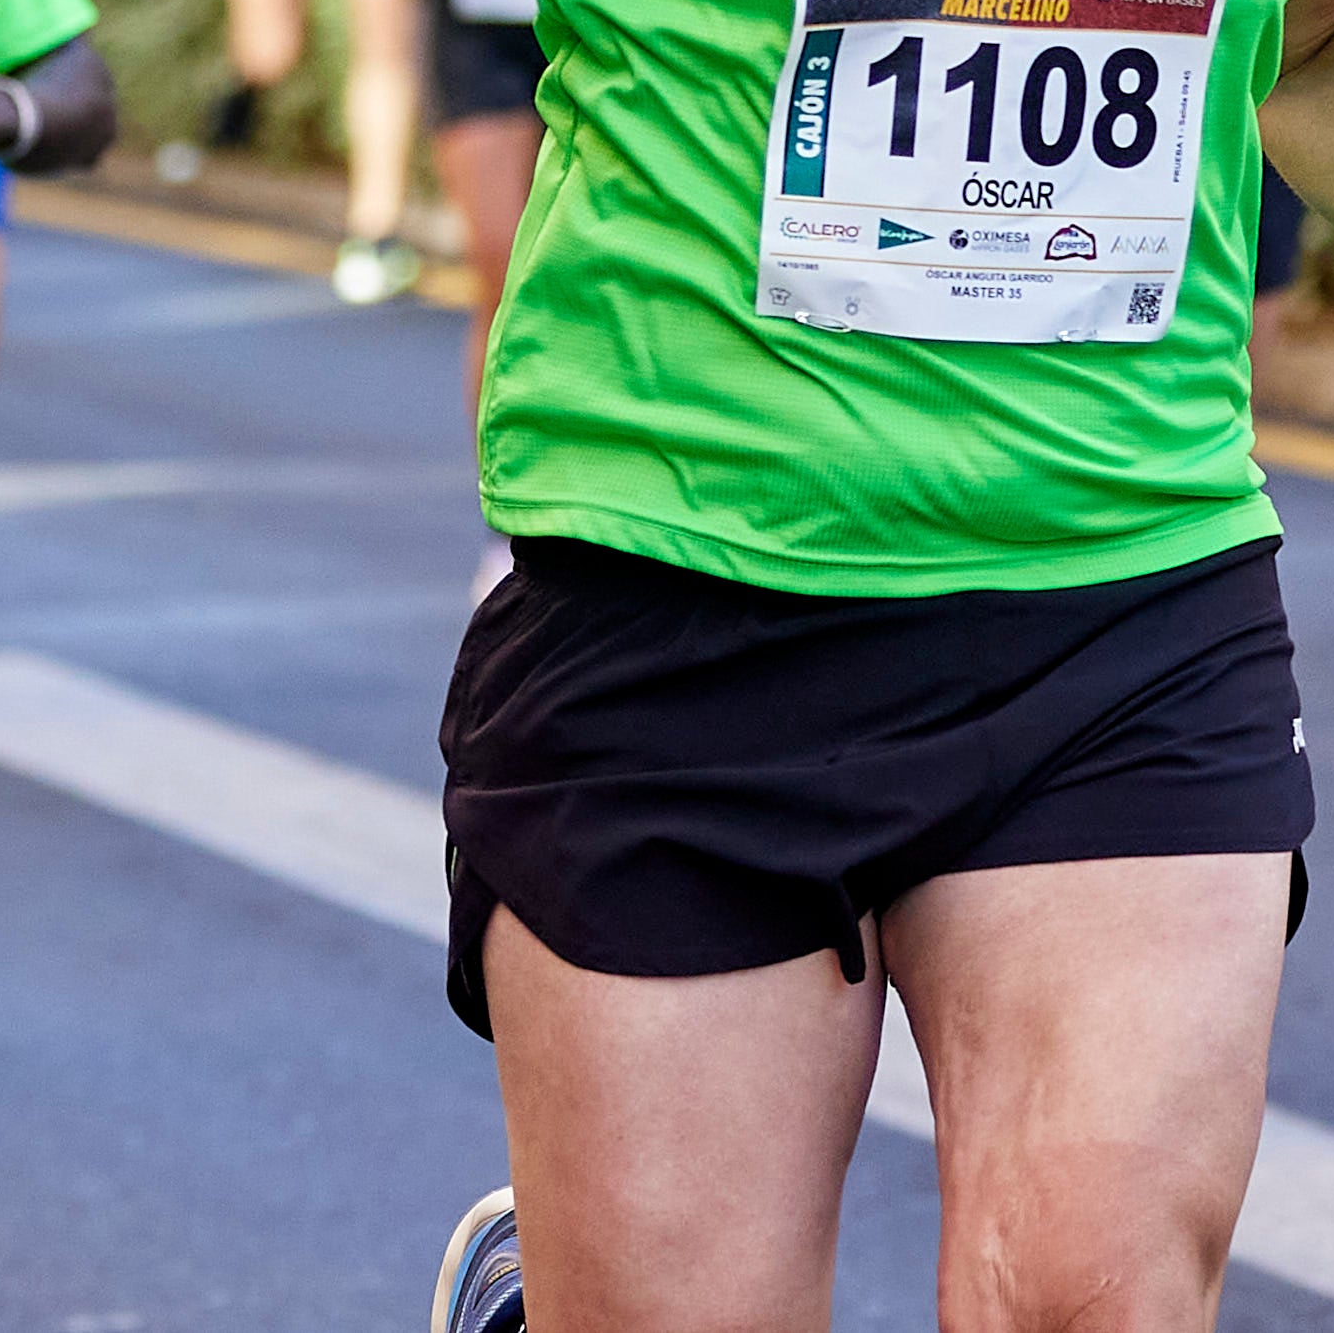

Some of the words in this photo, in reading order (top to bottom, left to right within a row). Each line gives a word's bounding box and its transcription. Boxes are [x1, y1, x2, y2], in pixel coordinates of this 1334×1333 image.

[807, 56, 831, 71] 3
[866, 35, 1160, 170] 1108
[794, 79, 827, 158] CAJÓN
[962, 171, 1055, 209] ÓSCAR
[786, 221, 859, 238] CALERO
[972, 230, 1030, 243] OXIMESA
[1110, 235, 1170, 254] ANAYA
[925, 269, 962, 280] ÓSCAR
[965, 271, 1006, 281] ANGUITA
[1009, 274, 1053, 283] GARRIDO
[951, 286, 1004, 298] MASTER
[1008, 288, 1022, 299] 35
